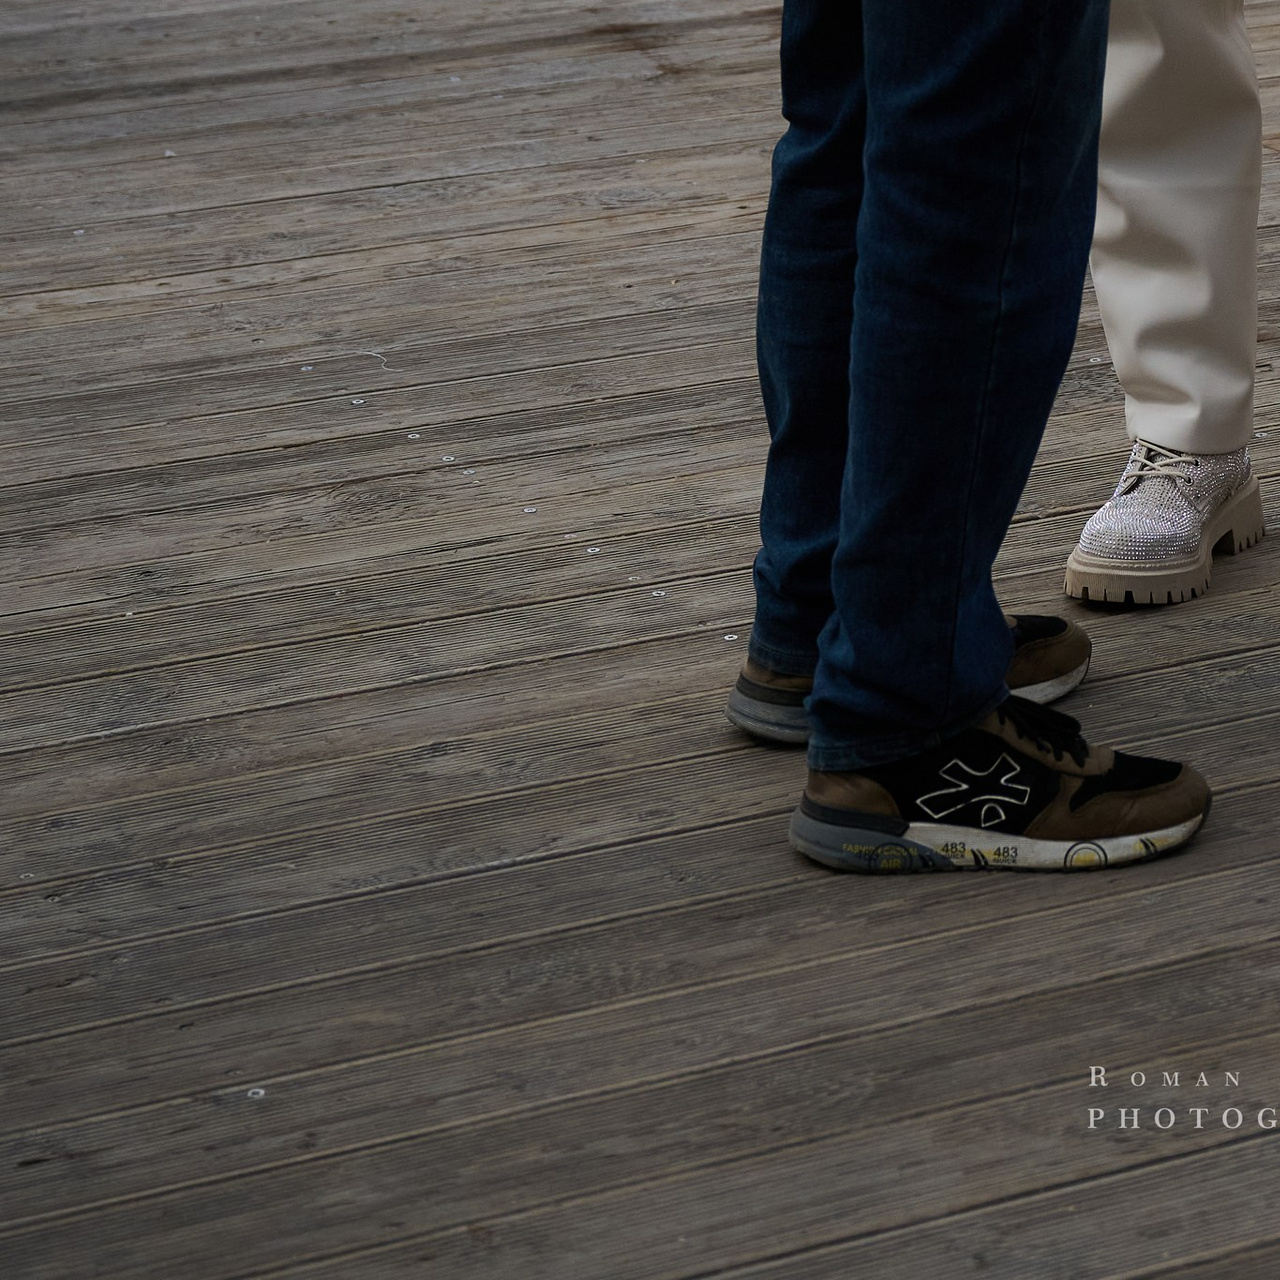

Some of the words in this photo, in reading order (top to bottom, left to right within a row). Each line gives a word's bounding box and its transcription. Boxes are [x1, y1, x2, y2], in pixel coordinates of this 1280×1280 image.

[941, 842, 966, 854] 483
[993, 846, 1018, 859] 483
[881, 859, 901, 870] AIR
